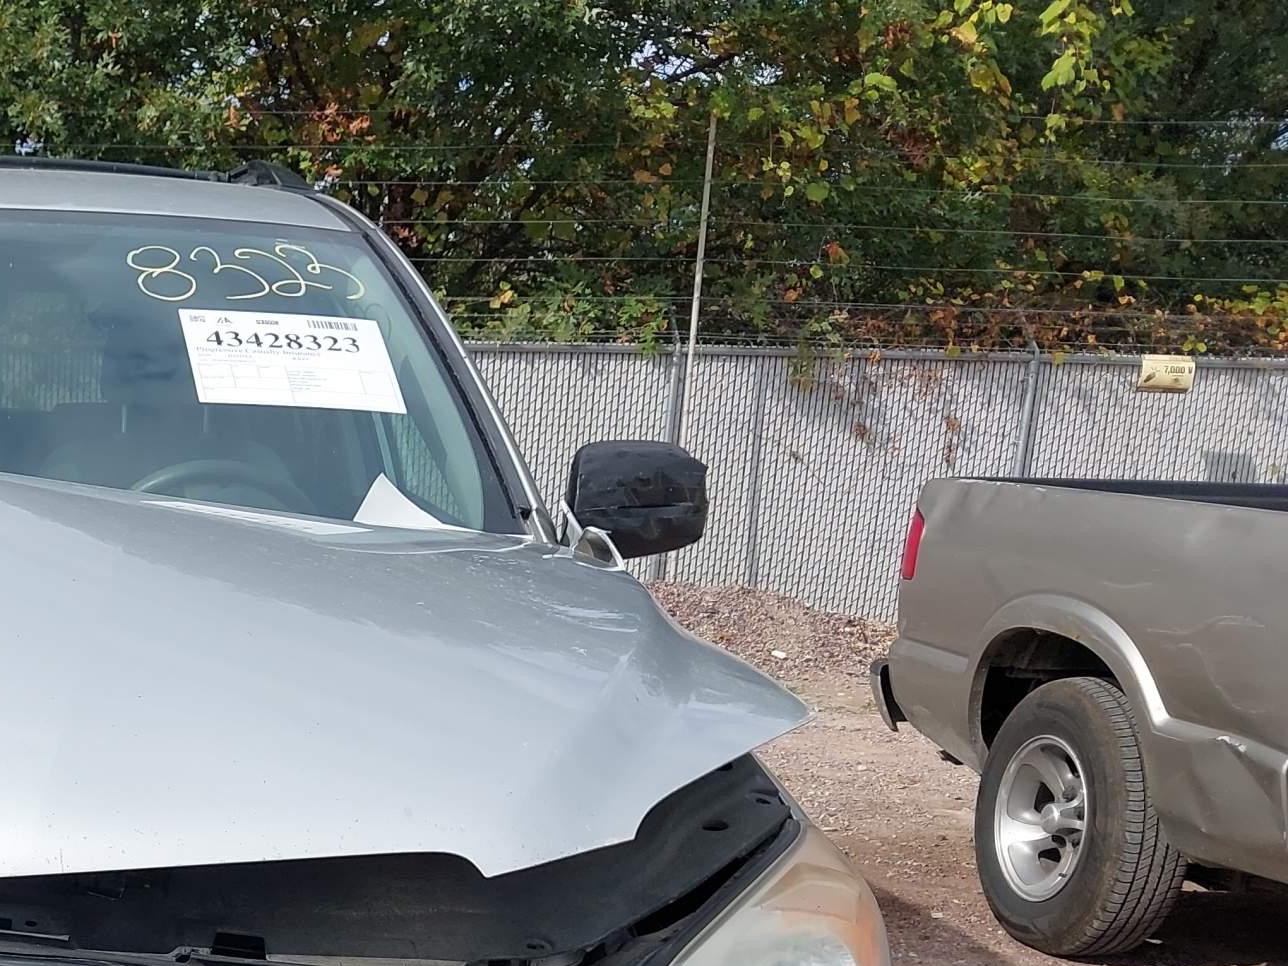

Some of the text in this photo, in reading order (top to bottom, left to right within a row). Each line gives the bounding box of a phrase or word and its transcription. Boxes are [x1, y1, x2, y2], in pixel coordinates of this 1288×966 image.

[126, 244, 366, 302] 8323
[206, 329, 361, 354] 43428323
[1163, 364, 1194, 375] 7,000 V
